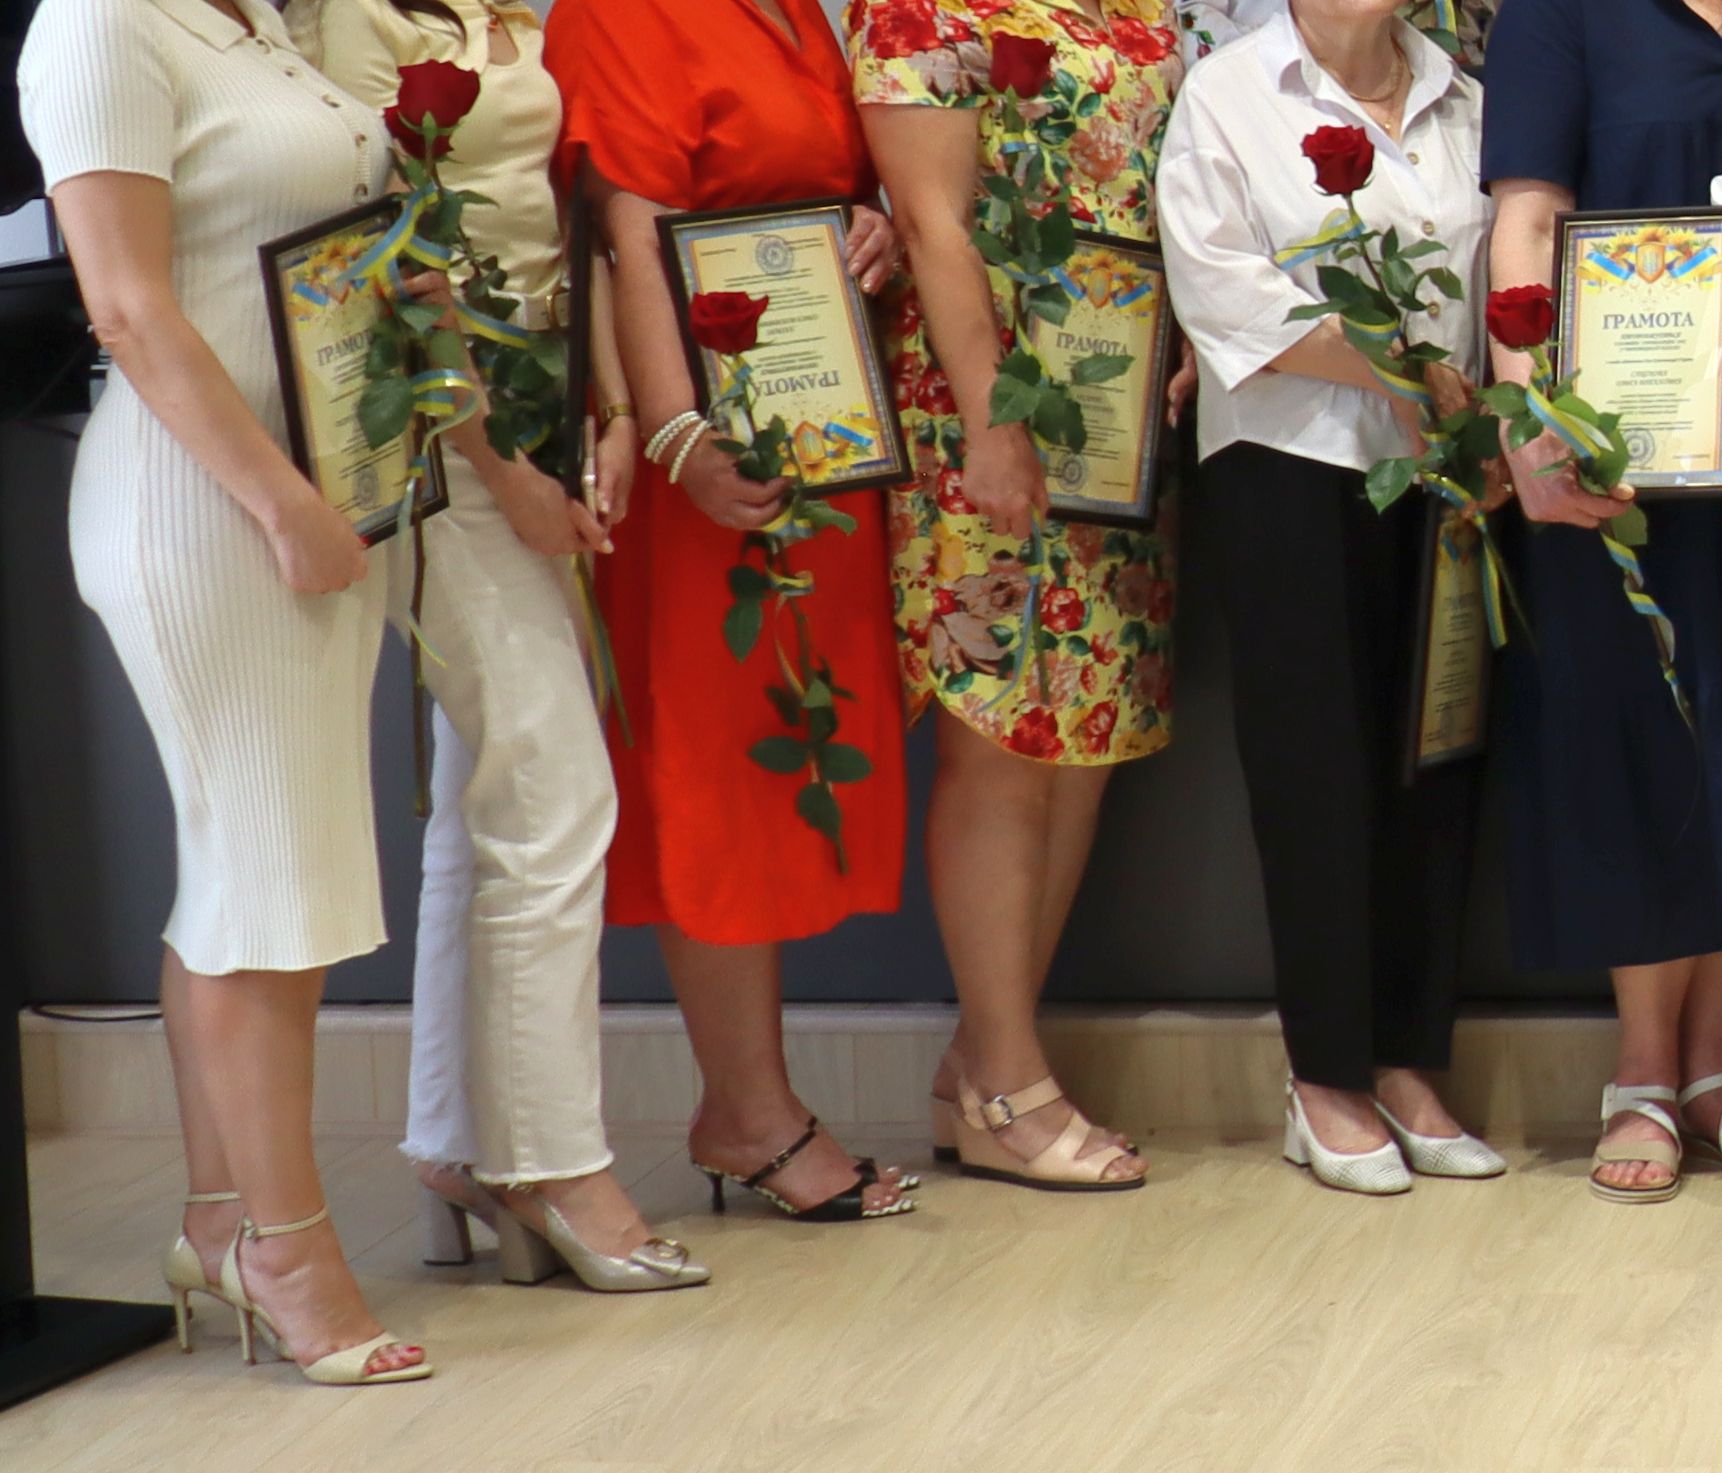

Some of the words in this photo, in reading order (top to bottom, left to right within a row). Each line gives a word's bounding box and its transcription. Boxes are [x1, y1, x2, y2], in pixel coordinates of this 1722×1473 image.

[1602, 312, 1695, 330] ГРАМОТА
[1056, 332, 1128, 355] ГРАМОТА
[754, 370, 841, 398] ГРАМОТА
